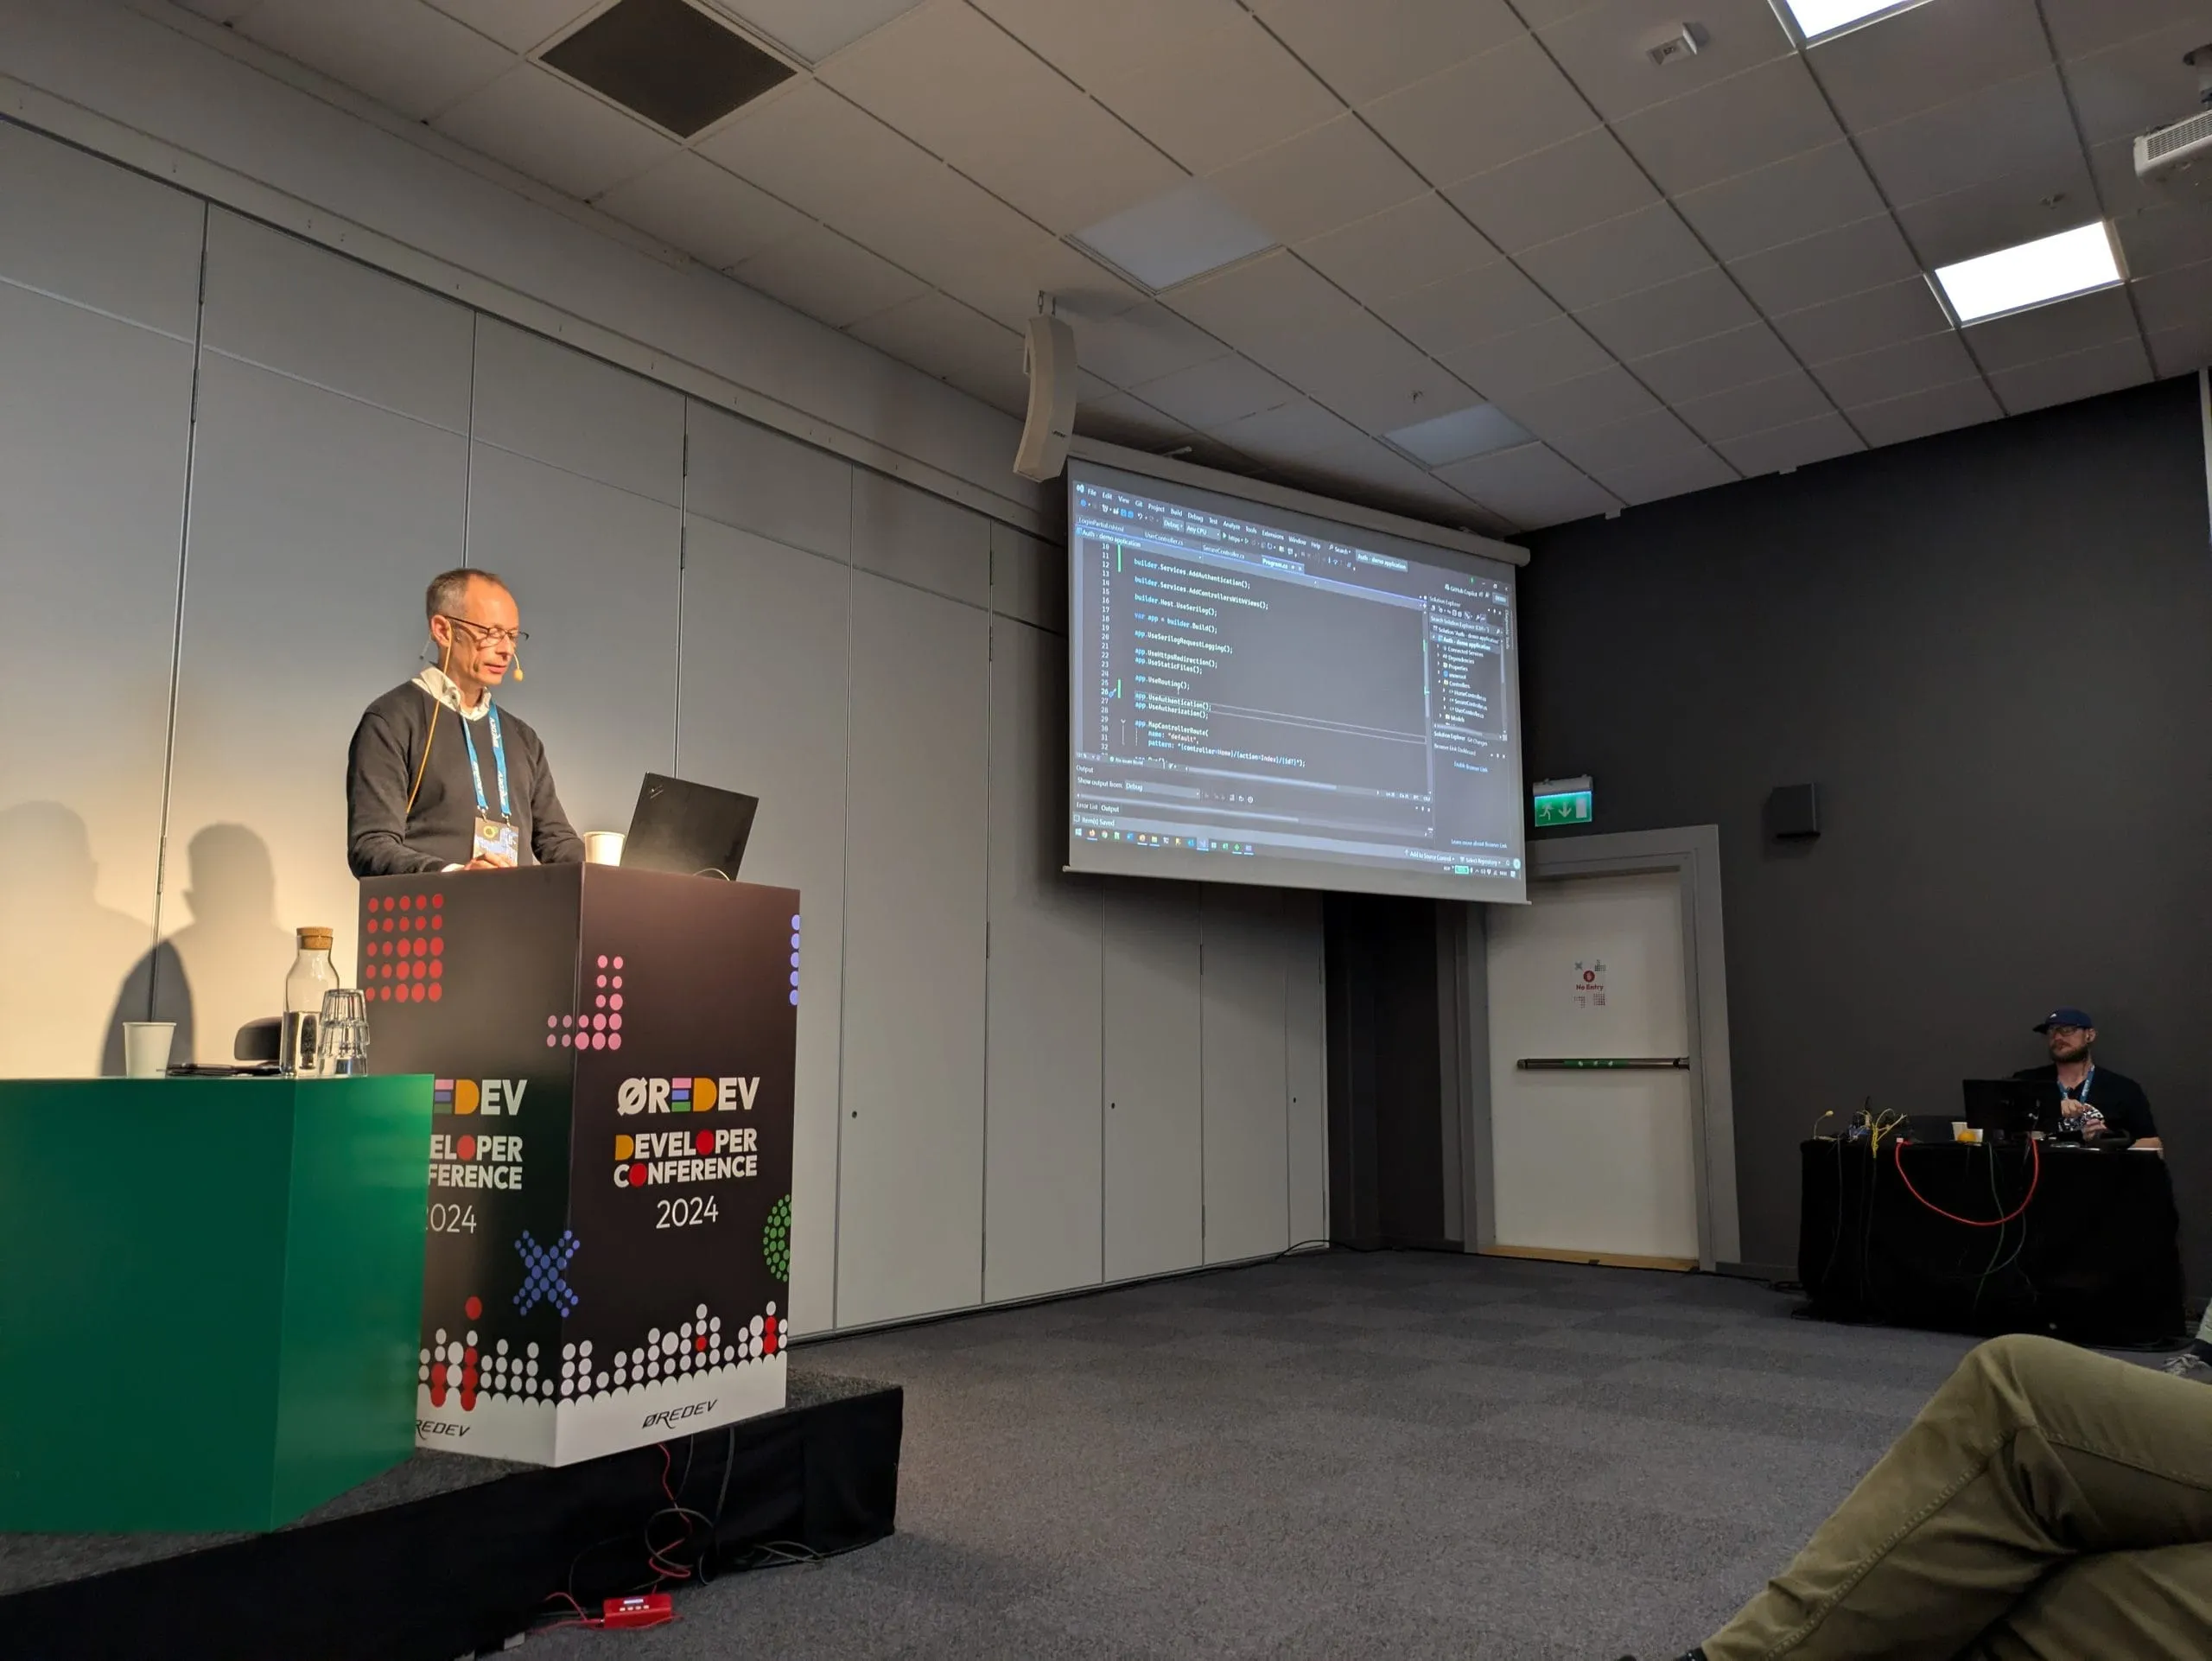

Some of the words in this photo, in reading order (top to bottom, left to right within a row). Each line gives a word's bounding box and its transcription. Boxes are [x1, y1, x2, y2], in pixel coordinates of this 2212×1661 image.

[1087, 487, 1096, 496] File
[1103, 491, 1113, 500] Edit
[1148, 503, 1165, 513] Project
[1170, 508, 1182, 517] Build
[1188, 512, 1203, 522] Debug
[1262, 530, 1284, 540] Extensions
[1289, 536, 1306, 545] Window
[1163, 520, 1179, 531] Debug
[1135, 657, 1203, 674] app.UseStaticFiles();
[1135, 693, 1211, 711] app.UseAuthentication();
[1135, 702, 1208, 719] app.UseAuthorization();
[1077, 765, 1094, 773] Output
[1092, 780, 1109, 788] output
[1125, 783, 1142, 792] Debug
[1101, 804, 1120, 813] Output
[617, 1077, 760, 1117] ØREDEV
[615, 1128, 758, 1161] DEVELOPER
[613, 1155, 758, 1188] CONFERENCE
[426, 1203, 477, 1234] 024
[656, 1195, 719, 1229] 2024
[641, 1399, 717, 1429] ØREDEV
